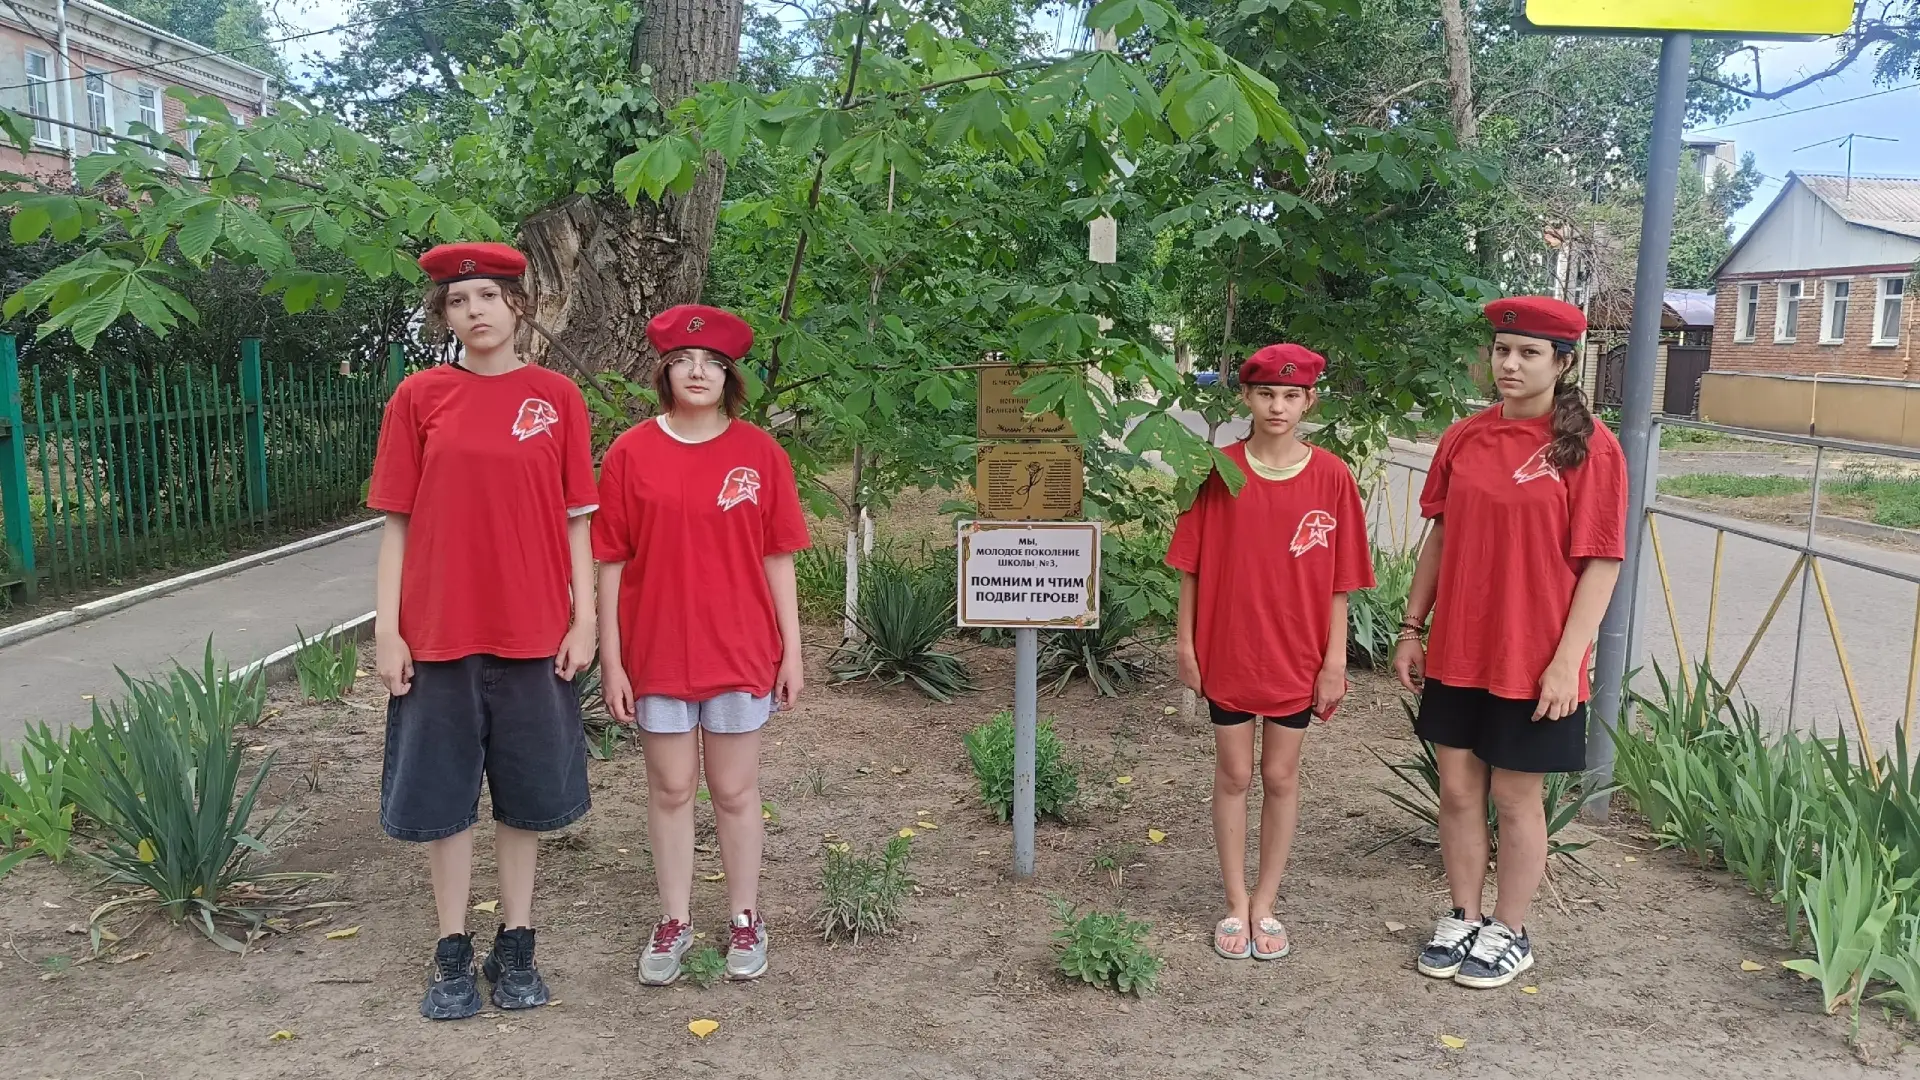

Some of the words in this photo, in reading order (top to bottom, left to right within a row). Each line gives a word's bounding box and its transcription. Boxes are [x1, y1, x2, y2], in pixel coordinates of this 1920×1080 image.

[1018, 538, 1038, 546] МЫ,
[976, 548, 1023, 557] МОЛОДОЕ
[1024, 549, 1080, 557] ПОКОЛЕНИЕ
[998, 559, 1035, 567] ШКОЛЫ
[971, 576, 1032, 587] ПОМНИМ
[1036, 578, 1044, 588] И
[1048, 577, 1084, 588] ЧТИМ
[976, 592, 1027, 603] ПОДВИГ
[1030, 592, 1079, 603] ГЕРОЕВ!
